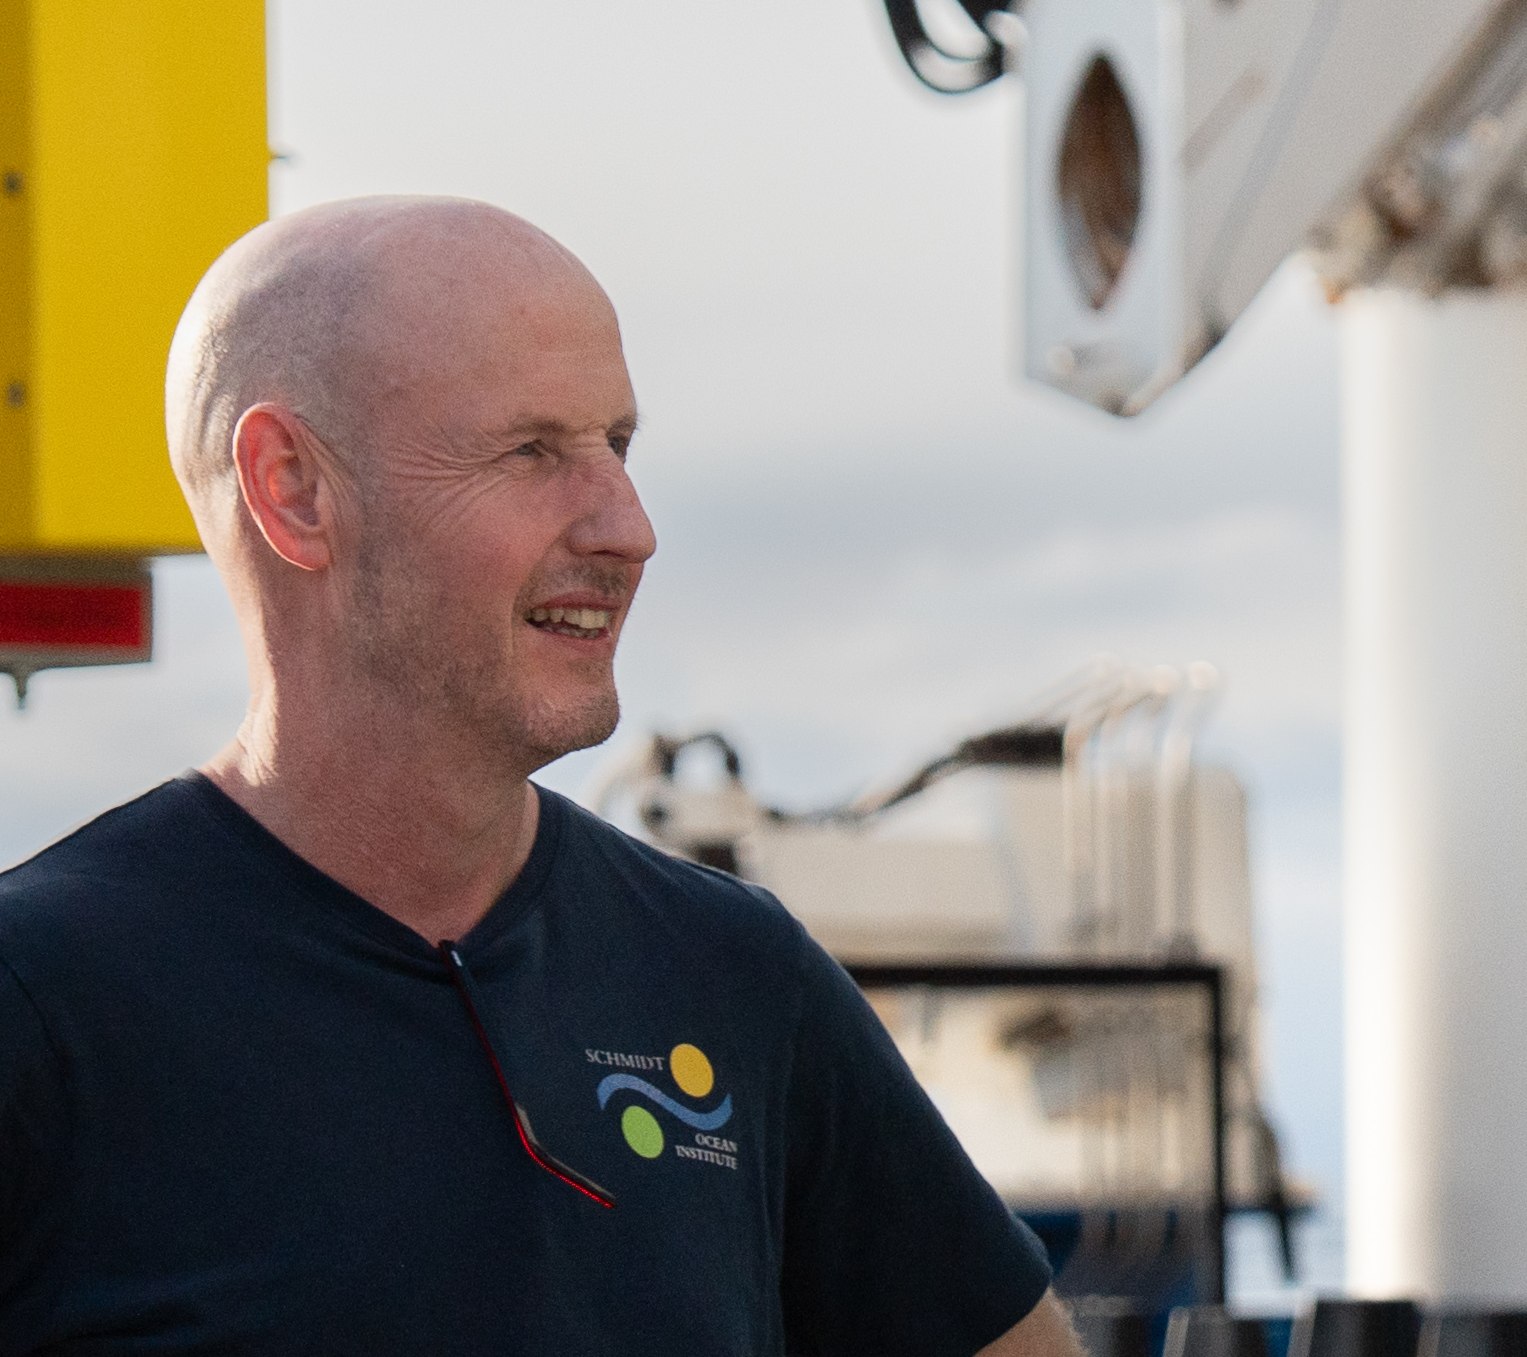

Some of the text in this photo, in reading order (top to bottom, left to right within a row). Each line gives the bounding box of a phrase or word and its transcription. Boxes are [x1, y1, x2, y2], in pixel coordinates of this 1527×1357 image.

[585, 1049, 665, 1070] SCHMIDT
[695, 1133, 738, 1152] OCEAN
[675, 1145, 738, 1170] INSTITUTE
